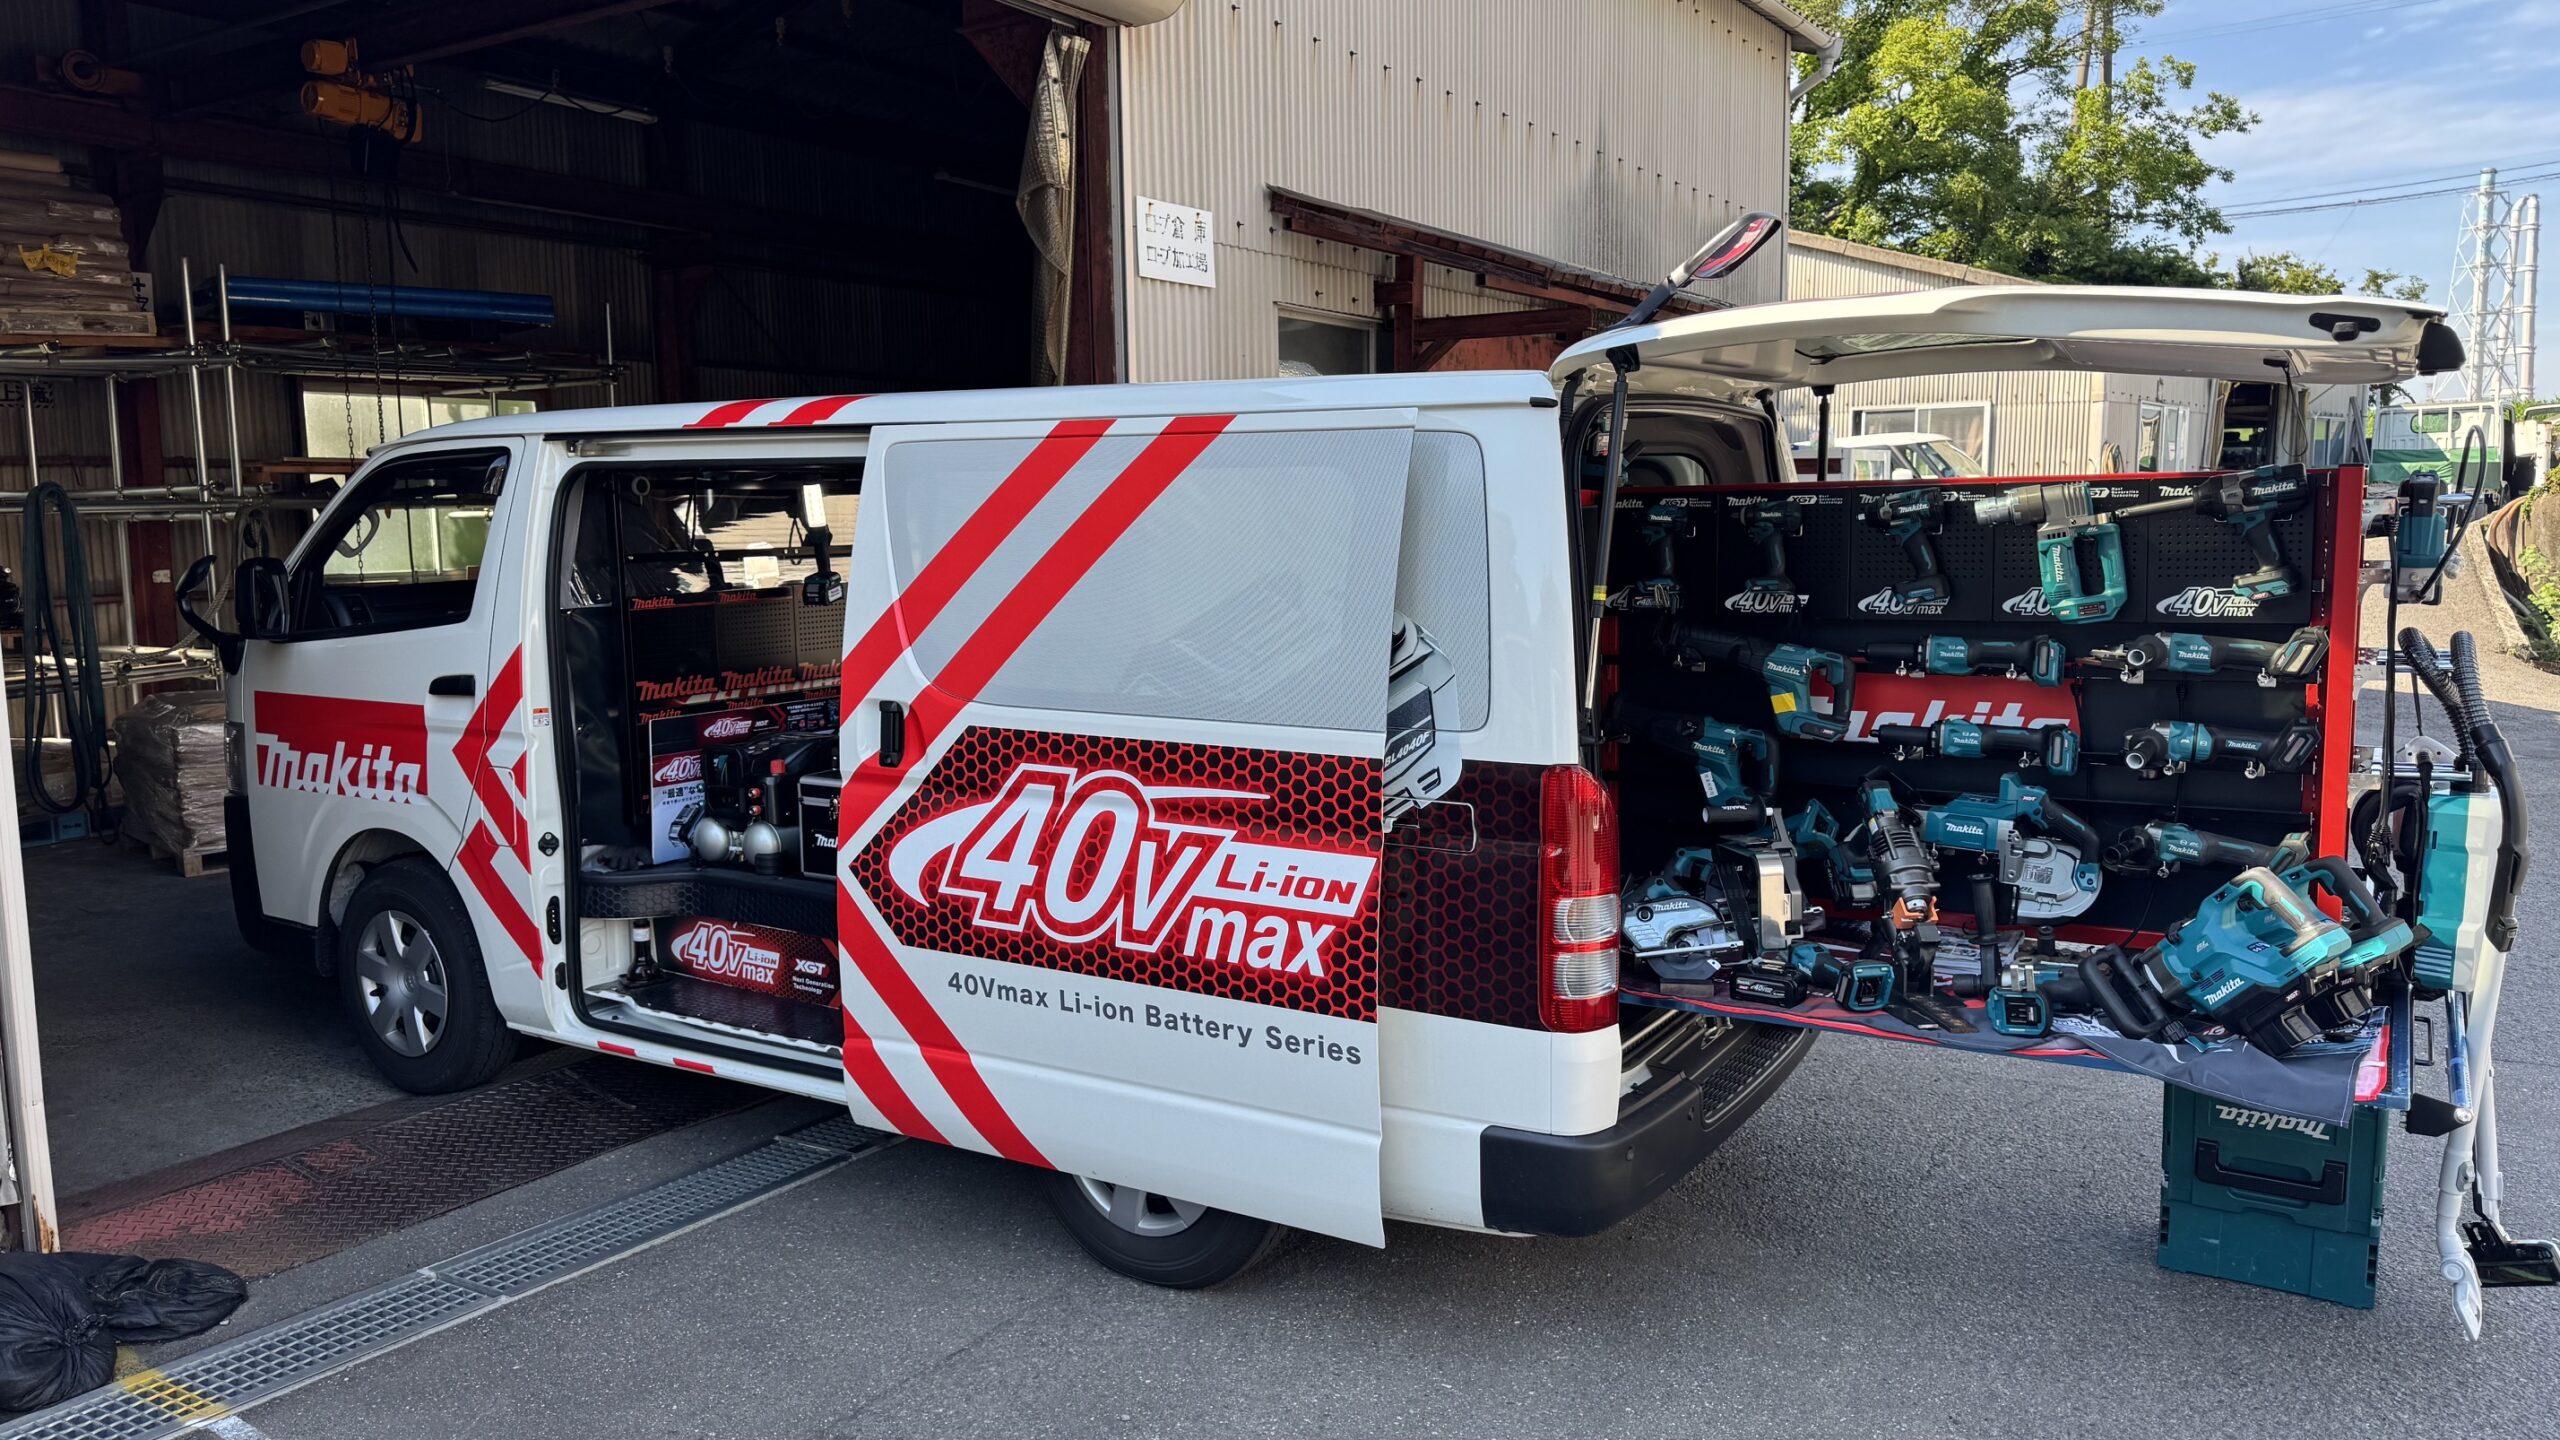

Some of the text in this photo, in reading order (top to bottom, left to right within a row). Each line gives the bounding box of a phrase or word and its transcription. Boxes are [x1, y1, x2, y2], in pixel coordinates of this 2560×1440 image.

[1183, 902, 1337, 978] max
[742, 963, 775, 984] max
[794, 958, 826, 976] XGT
[946, 971, 1363, 1066] 40Vmax Li-ion Battery Series
